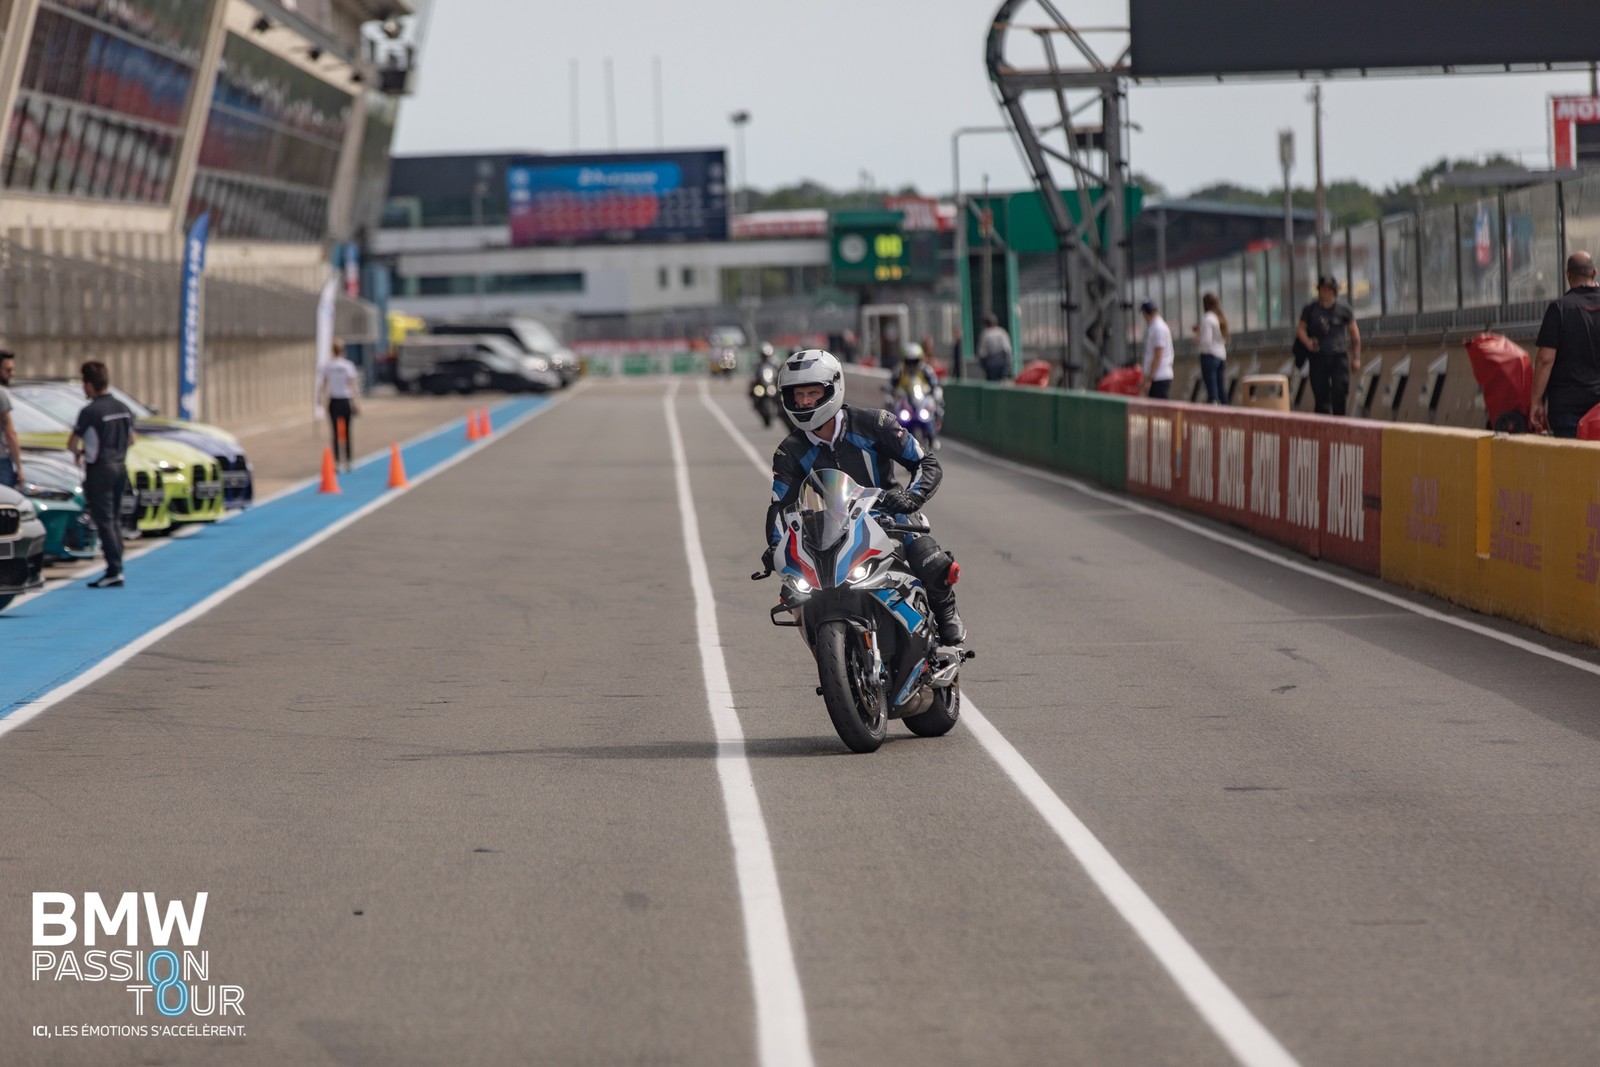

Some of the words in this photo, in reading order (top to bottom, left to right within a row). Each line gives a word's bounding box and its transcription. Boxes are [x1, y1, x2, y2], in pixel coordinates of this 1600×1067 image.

[184, 238, 203, 385] MICHELIN
[1219, 428, 1245, 510] MOTUL
[1251, 431, 1280, 519] MOTUL
[1287, 436, 1319, 530] MOTUL
[1327, 442, 1364, 541] MOTUL
